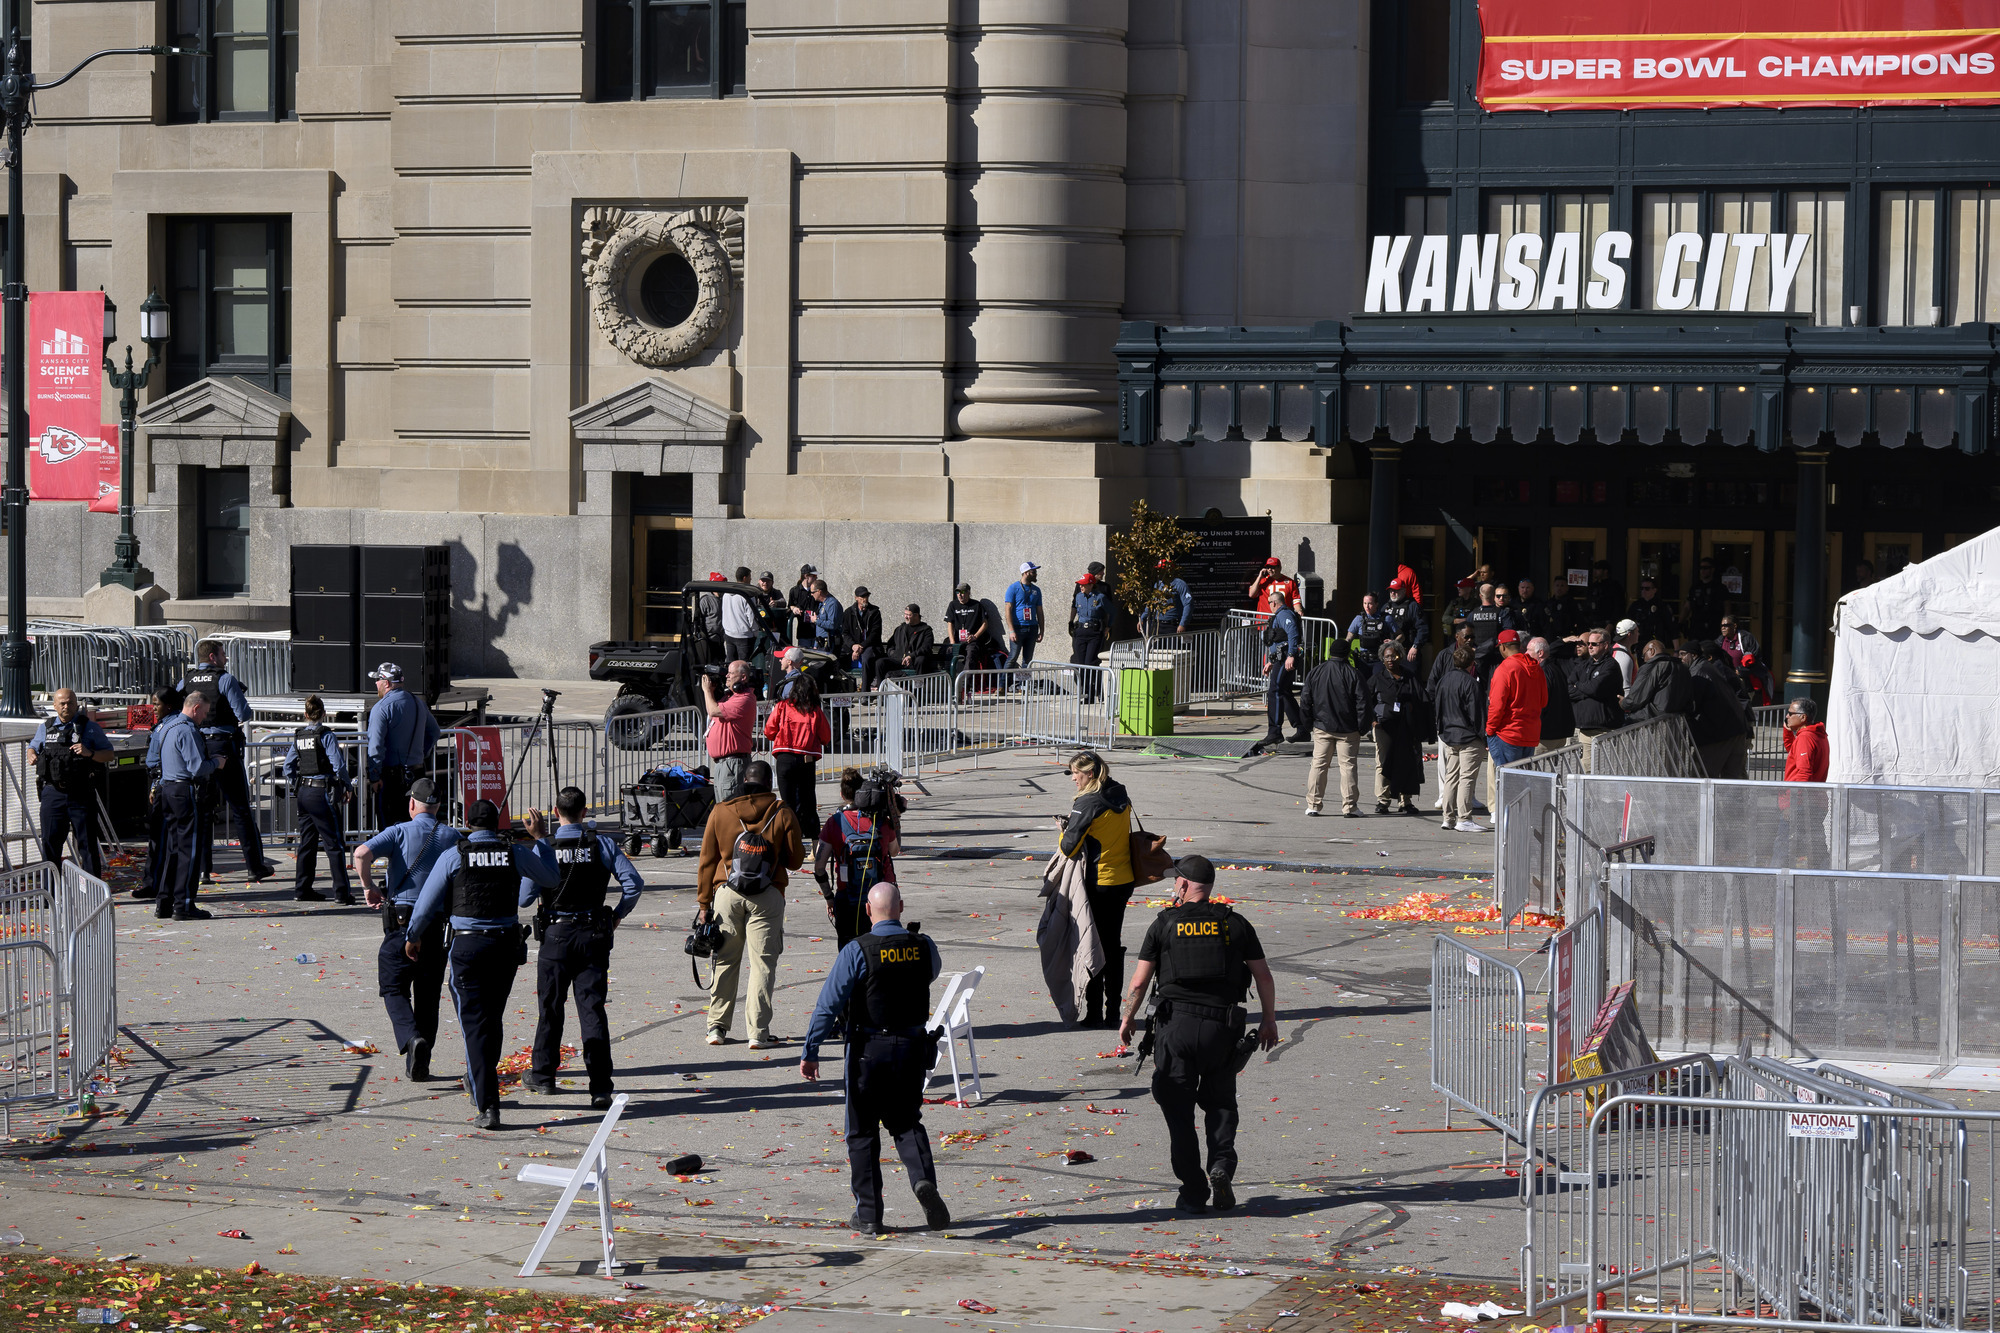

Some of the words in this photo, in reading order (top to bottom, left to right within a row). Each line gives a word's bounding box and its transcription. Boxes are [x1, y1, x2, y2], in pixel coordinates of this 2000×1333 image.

[1500, 58, 1622, 81] SUPER
[1633, 56, 1746, 80] BOWL
[1758, 52, 1995, 78] CHAMPIONS
[1364, 230, 1632, 312] KANSAS
[1656, 232, 1811, 312] CITY
[40, 366, 89, 375] SCIENCE
[1268, 585, 1285, 597] 15
[497, 762, 502, 770] 3
[469, 852, 509, 867] POLICE
[555, 848, 591, 864] POLICE
[1177, 922, 1218, 936] POLICE
[881, 947, 920, 963] POLICE
[1792, 1114, 1855, 1128] NATIONAL
